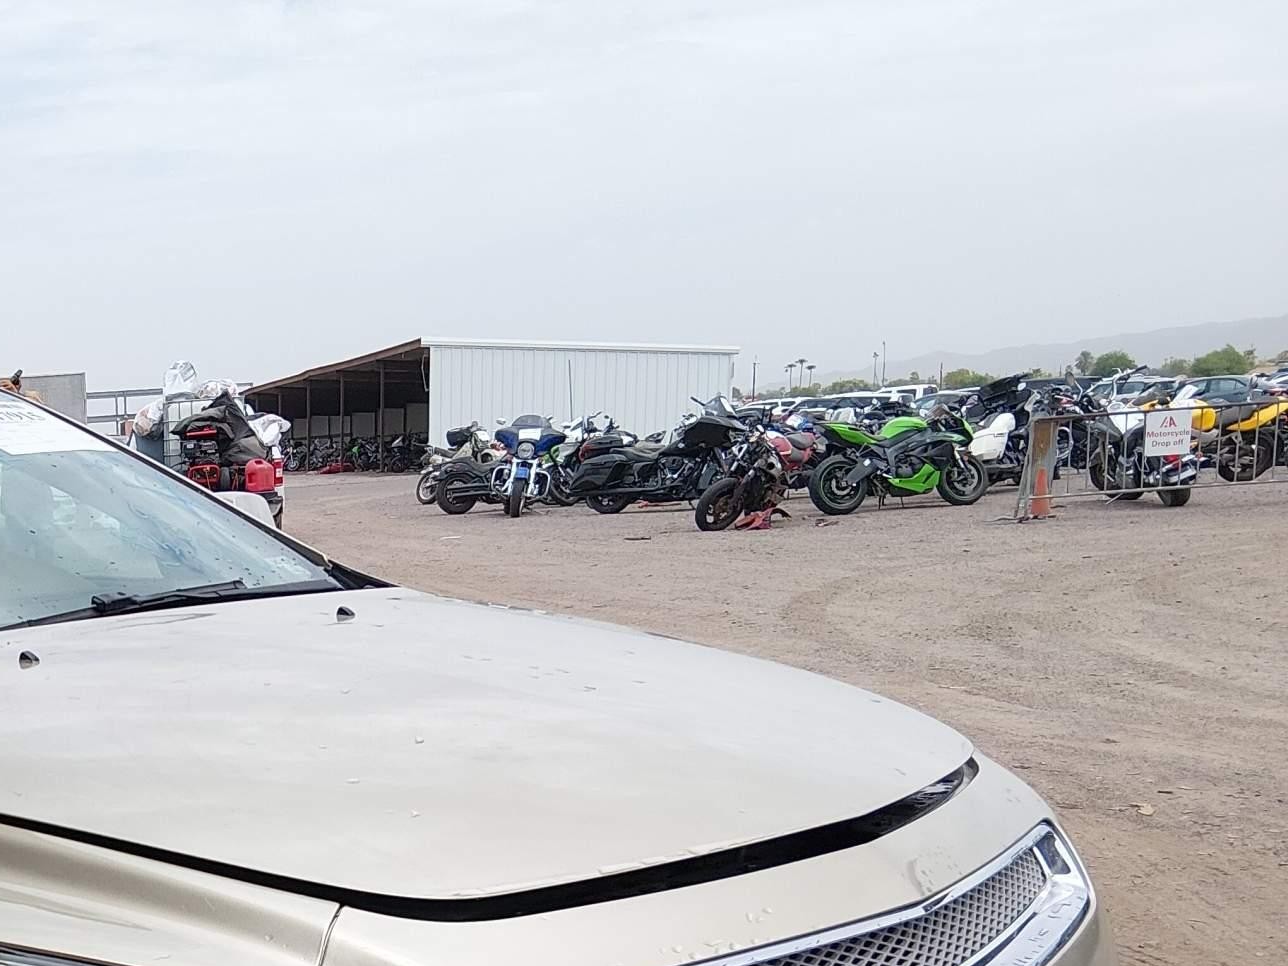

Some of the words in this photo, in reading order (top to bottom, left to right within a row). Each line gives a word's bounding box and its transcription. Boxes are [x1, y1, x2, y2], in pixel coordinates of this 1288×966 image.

[1146, 428, 1190, 439] Motorcycle
[1152, 440, 1171, 448] Drop
[1173, 438, 1184, 446] off
